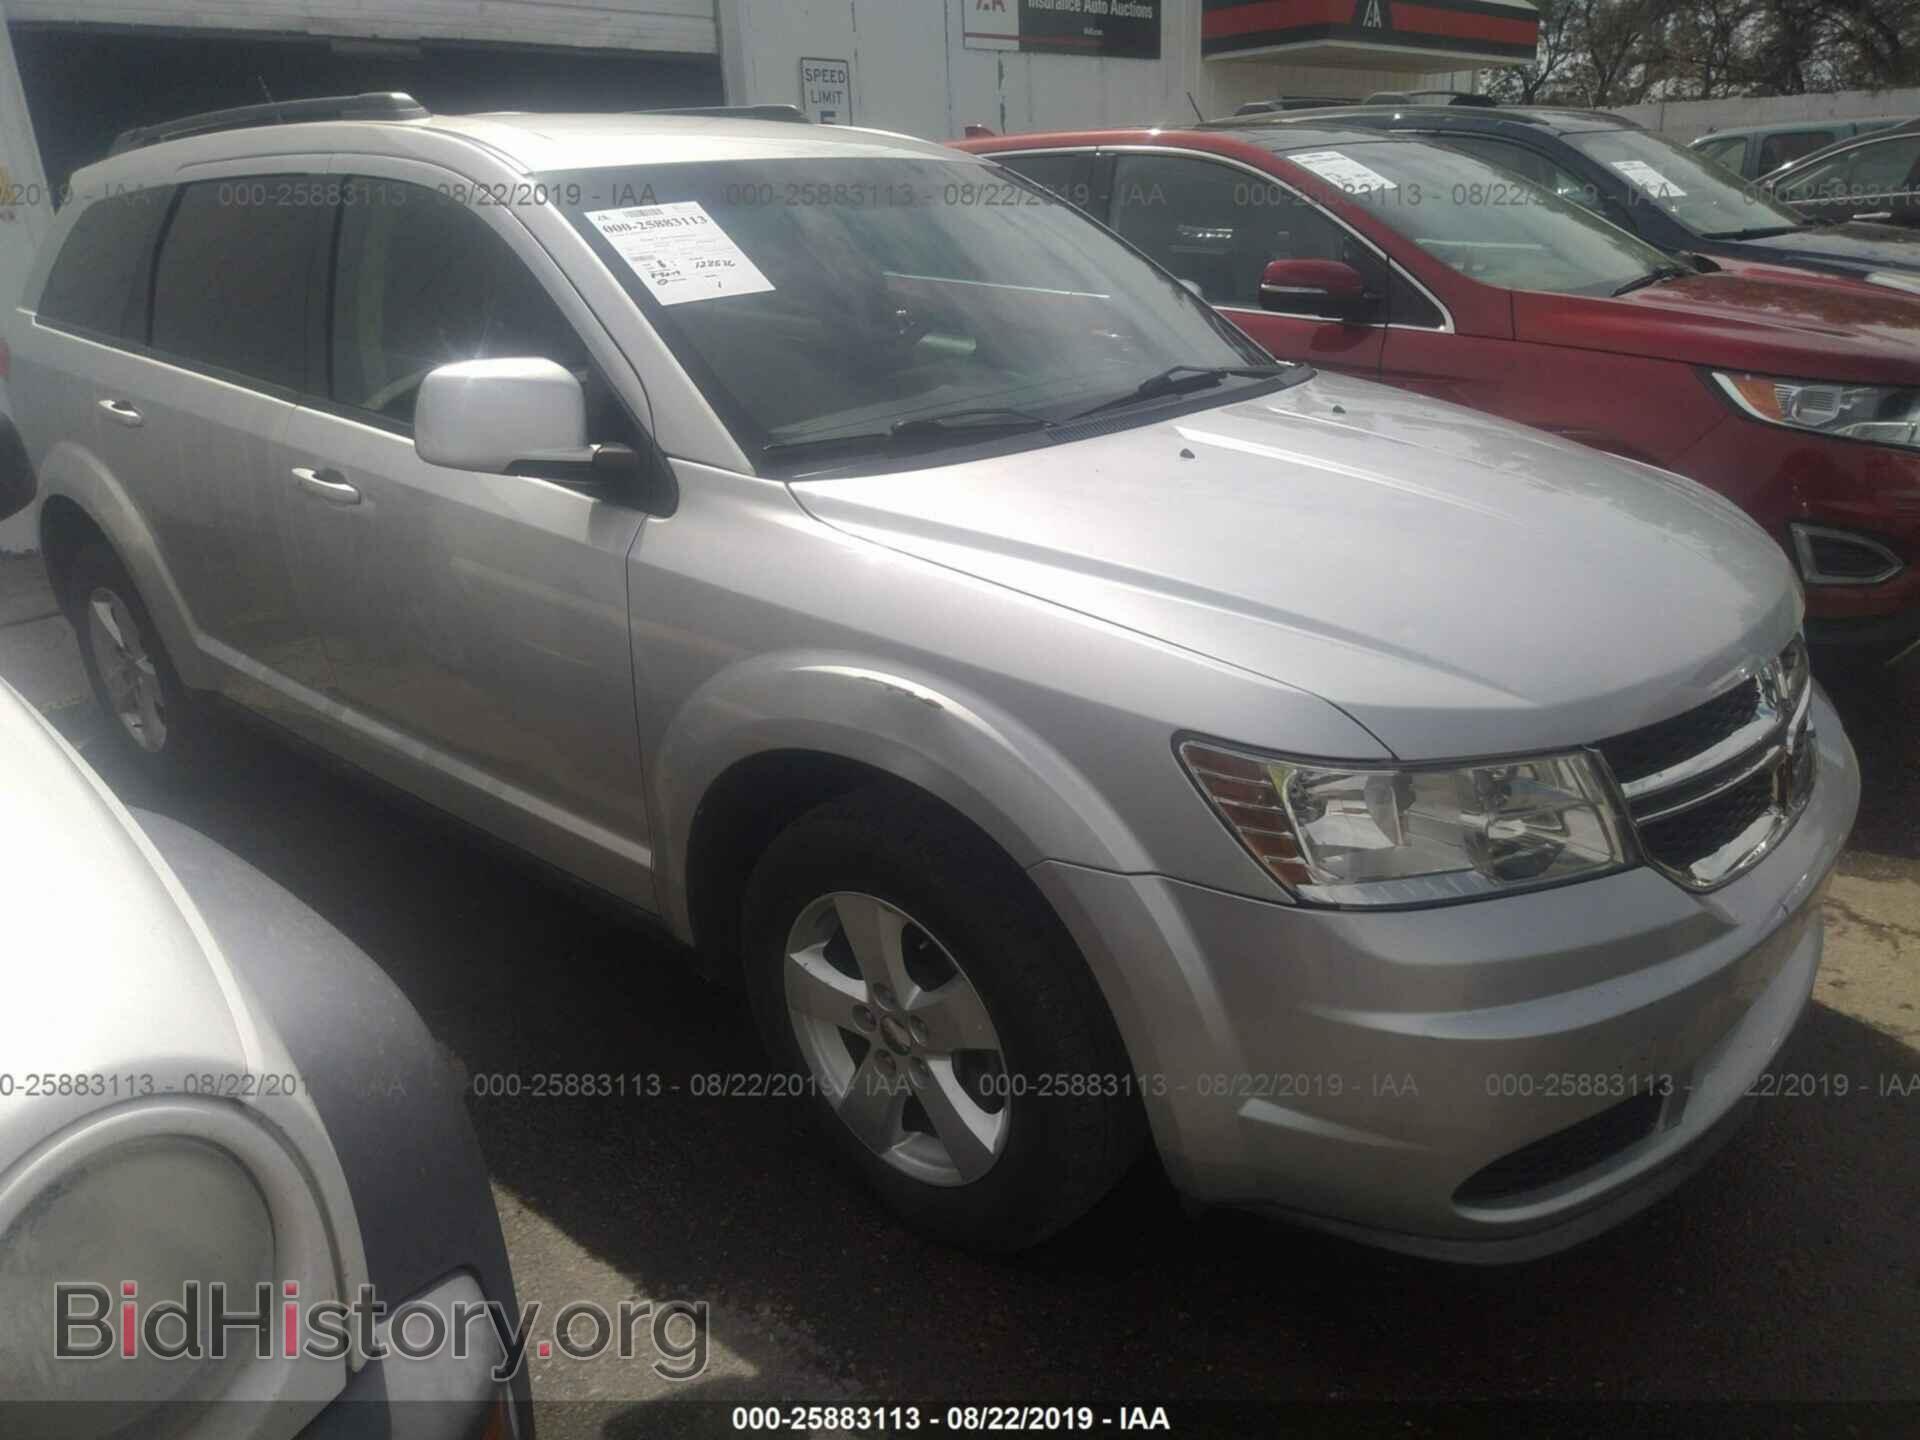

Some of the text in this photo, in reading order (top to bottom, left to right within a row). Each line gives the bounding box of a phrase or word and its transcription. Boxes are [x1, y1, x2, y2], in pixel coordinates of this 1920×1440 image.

[1083, 0, 1107, 15] Auto
[1109, 0, 1153, 19] Auctions
[805, 68, 846, 83] SPEED
[810, 89, 843, 104] LIMIT
